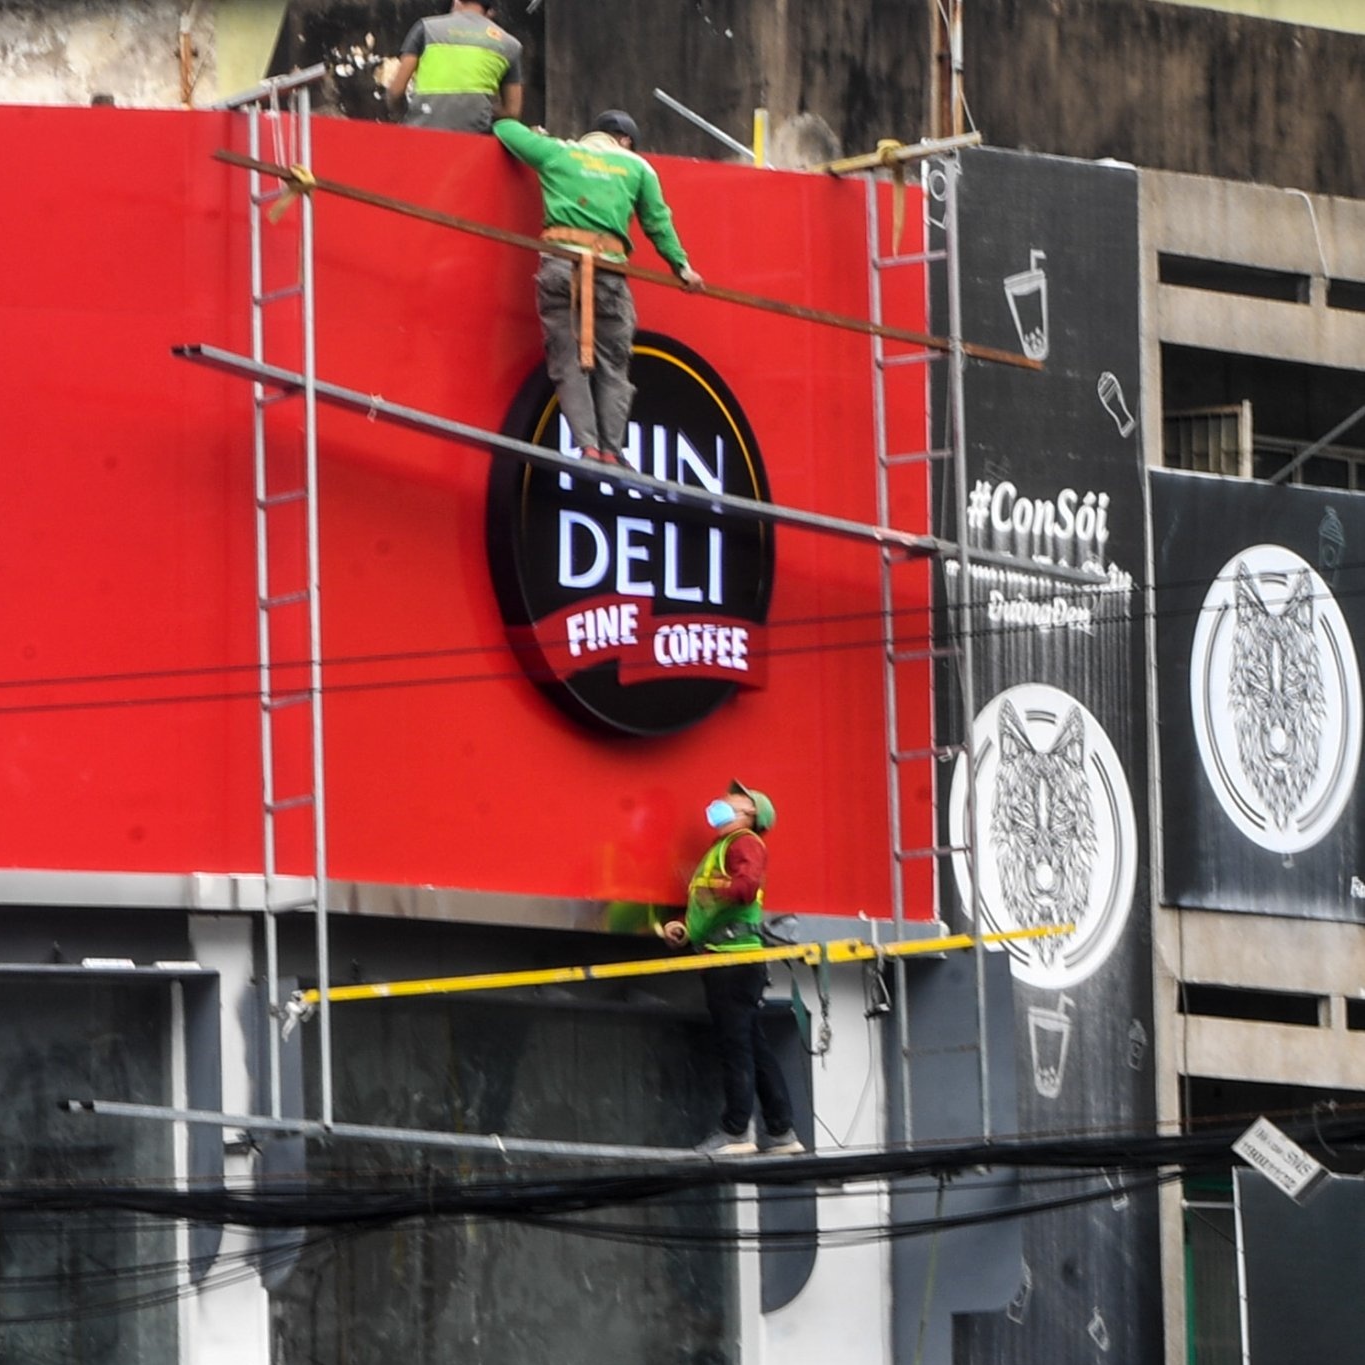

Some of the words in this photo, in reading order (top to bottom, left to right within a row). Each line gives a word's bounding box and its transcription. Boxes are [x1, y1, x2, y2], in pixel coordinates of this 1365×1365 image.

[558, 508, 723, 605] DELI
[566, 603, 639, 657] FINE
[653, 622, 749, 671] COFFEE
